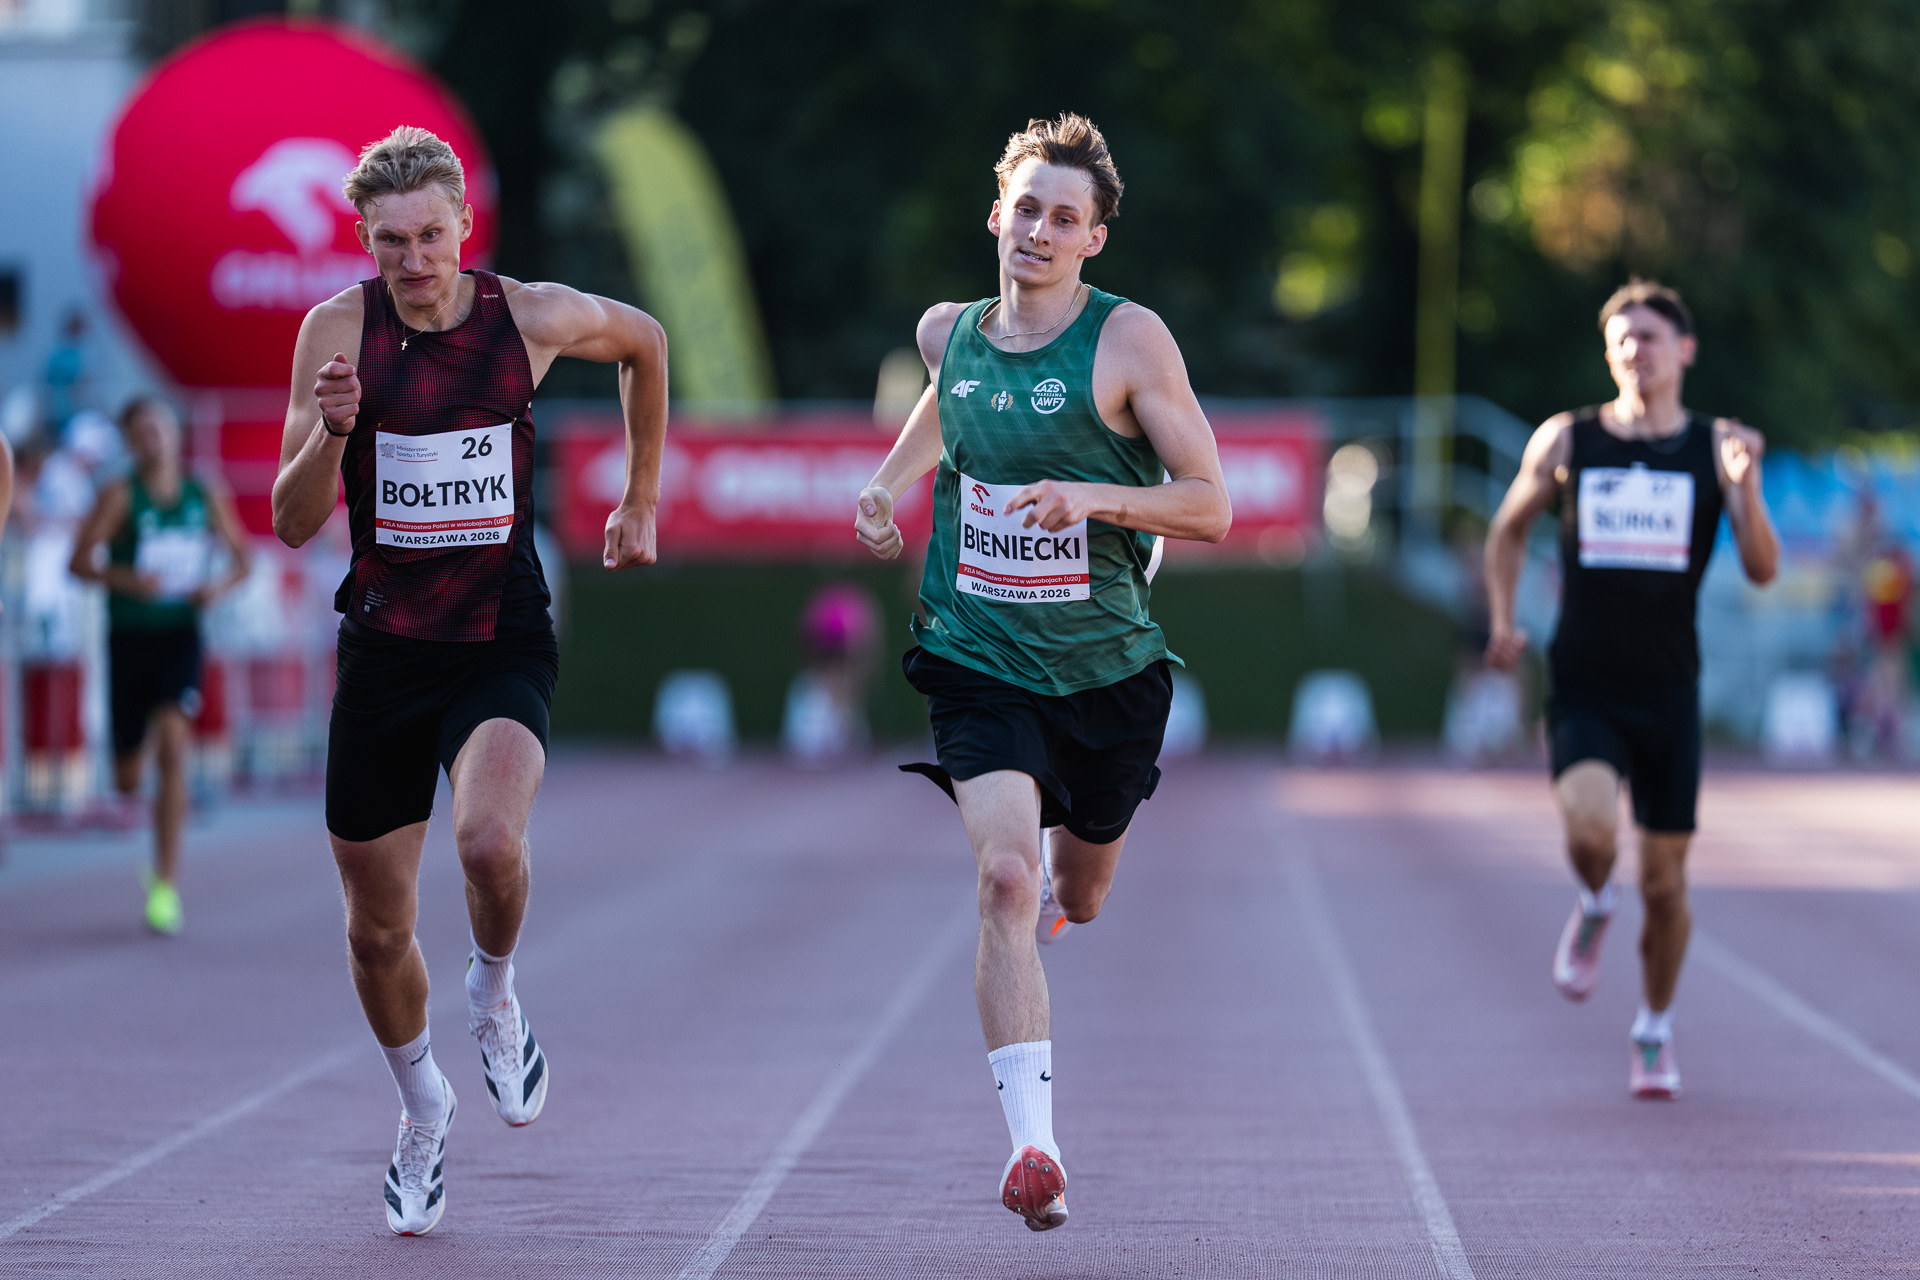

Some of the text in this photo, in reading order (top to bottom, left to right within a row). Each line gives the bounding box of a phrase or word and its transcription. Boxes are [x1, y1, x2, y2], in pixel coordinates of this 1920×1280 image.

[951, 379, 981, 398] 4F
[1040, 384, 1060, 393] AZS
[1036, 397, 1059, 407] AWF
[461, 434, 493, 460] 26
[382, 474, 508, 508] BOŁTRYK
[970, 502, 994, 517] ORLEN
[396, 522, 432, 530] Mistrzostwa
[432, 522, 449, 530] Polski
[456, 519, 492, 528] wielobojach
[493, 516, 509, 526] (U20)
[392, 531, 500, 545] WARSZAWA 2026
[964, 523, 1081, 561] BIENIECKI
[964, 566, 976, 574] PZLA
[1025, 576, 1063, 584] wielobojach
[1063, 574, 1081, 583] (U20)
[971, 581, 1071, 599] WARSZAWA 2026
